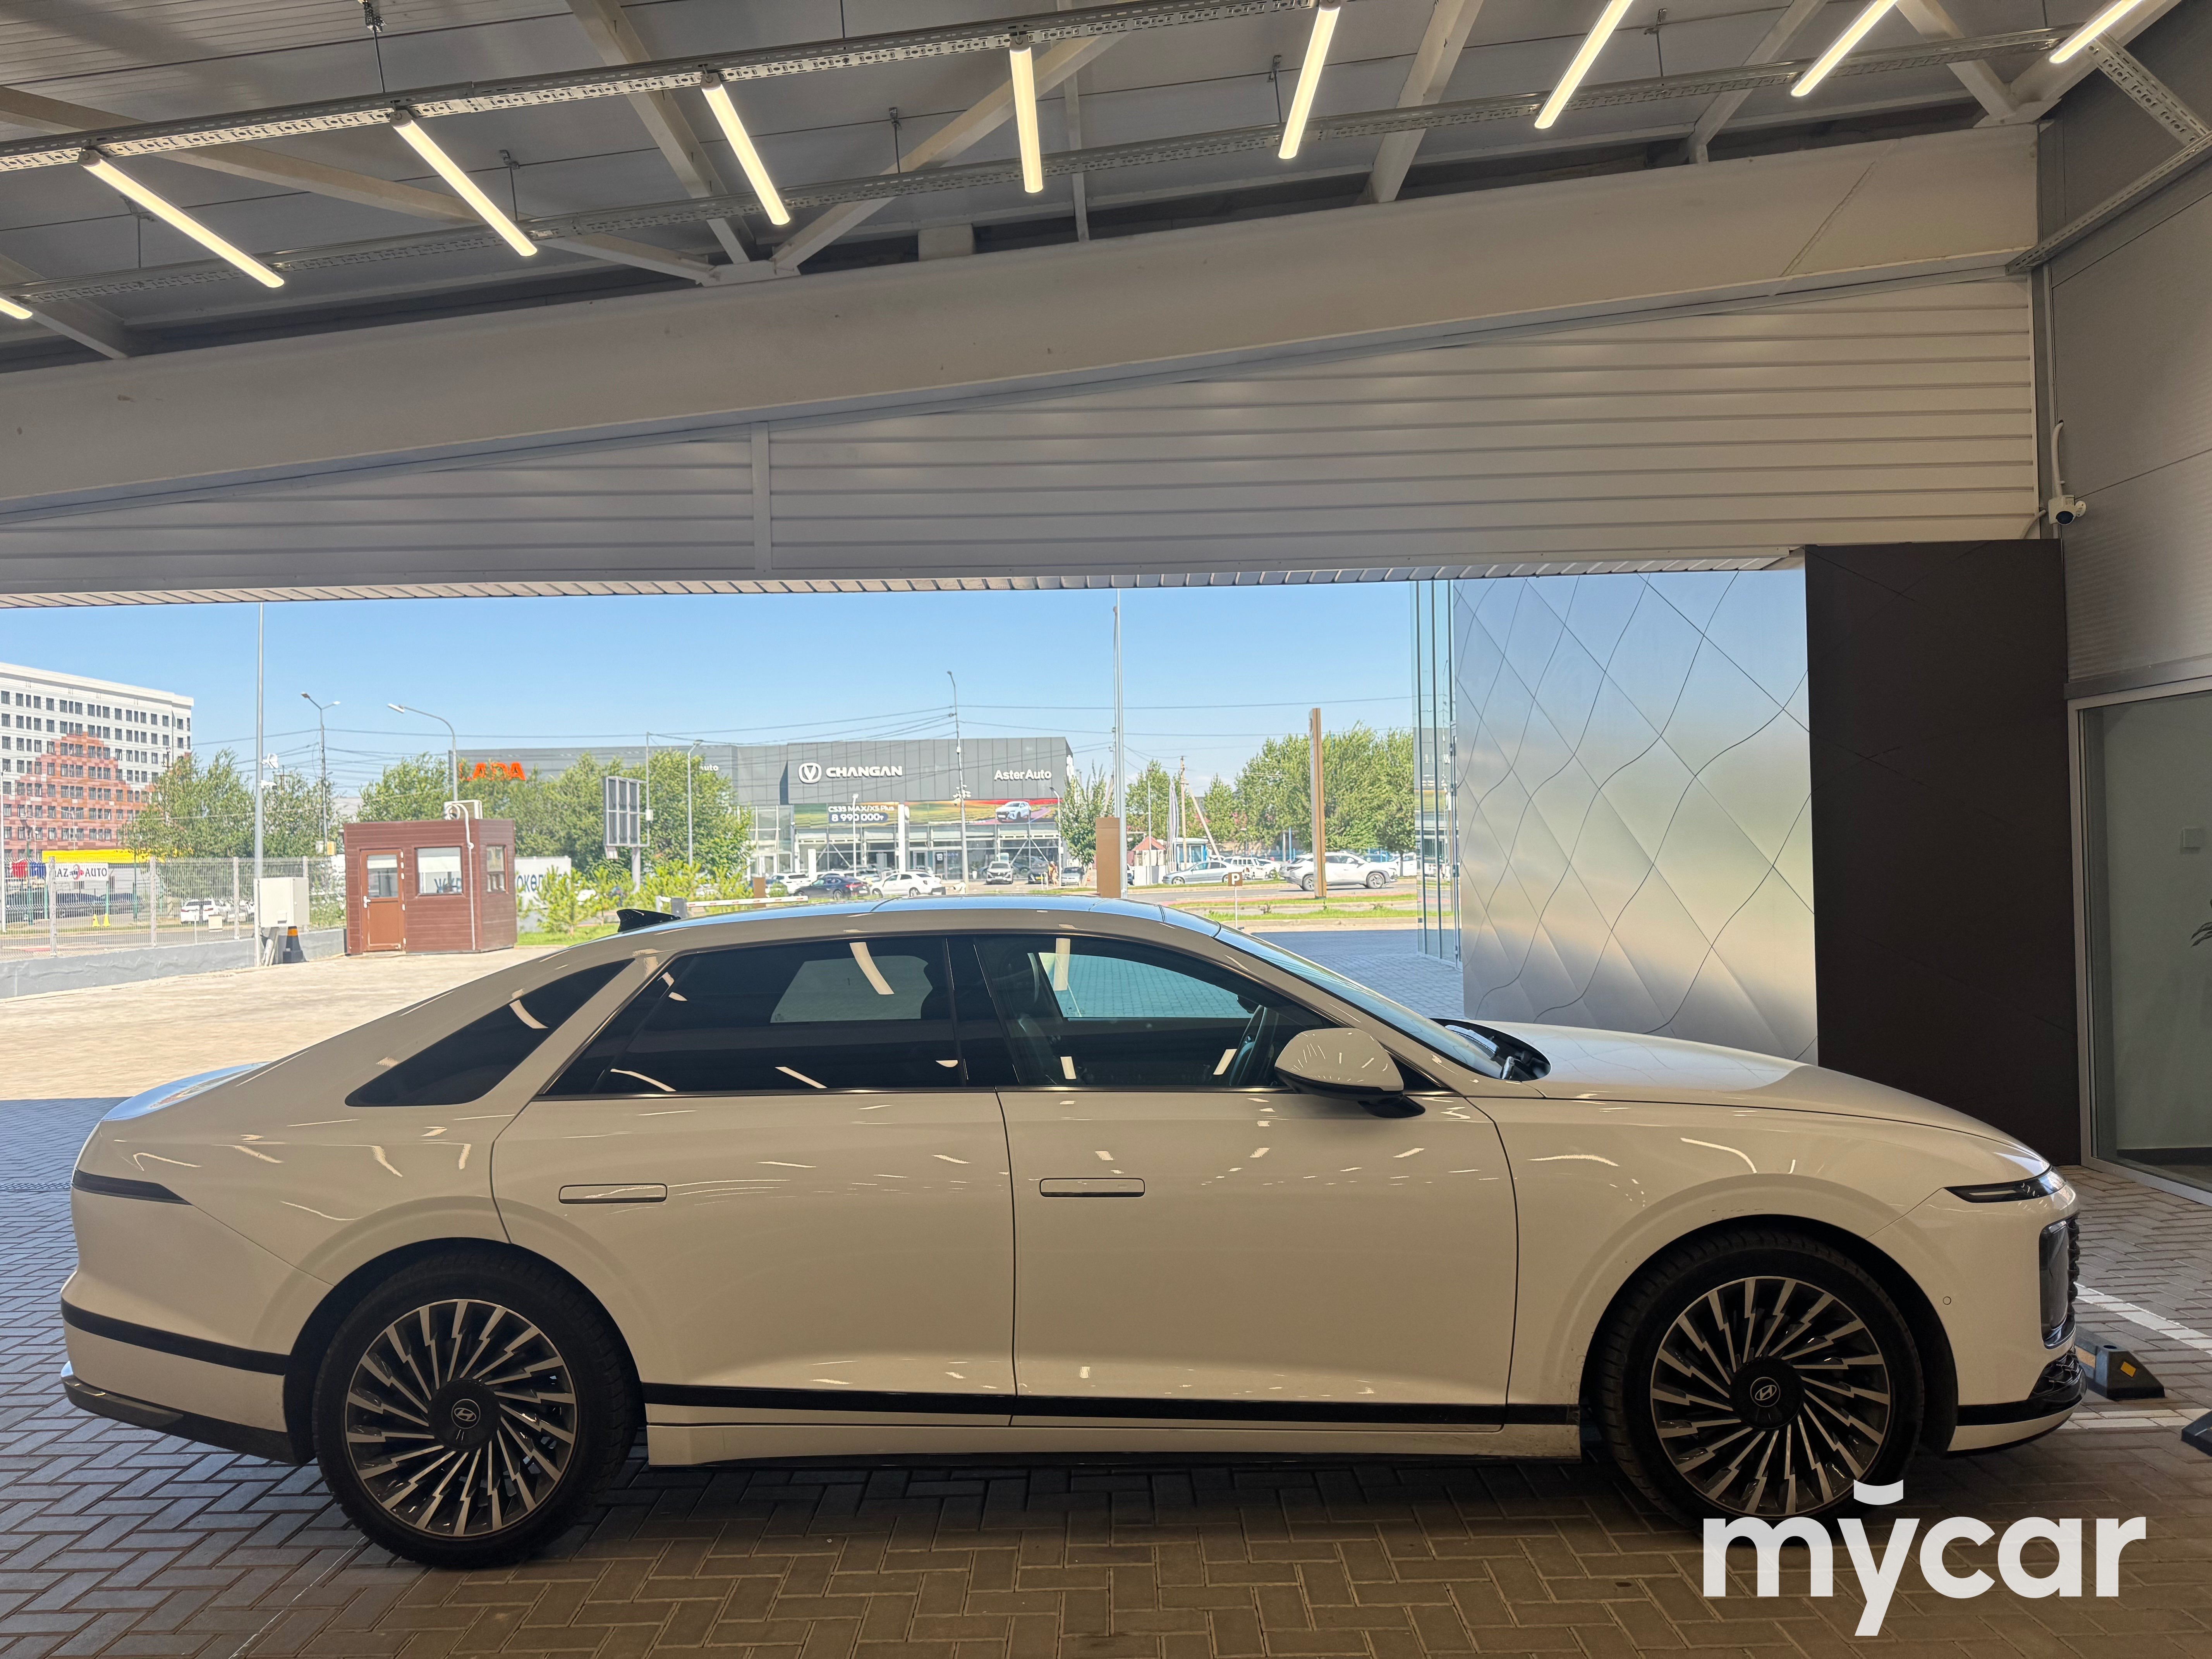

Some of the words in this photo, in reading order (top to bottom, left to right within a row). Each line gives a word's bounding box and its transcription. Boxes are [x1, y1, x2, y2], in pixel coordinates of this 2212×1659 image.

[826, 766, 903, 778] CHANGAN
[55, 868, 69, 877] AZ
[85, 867, 107, 877] AUTO
[1231, 873, 1240, 885] P
